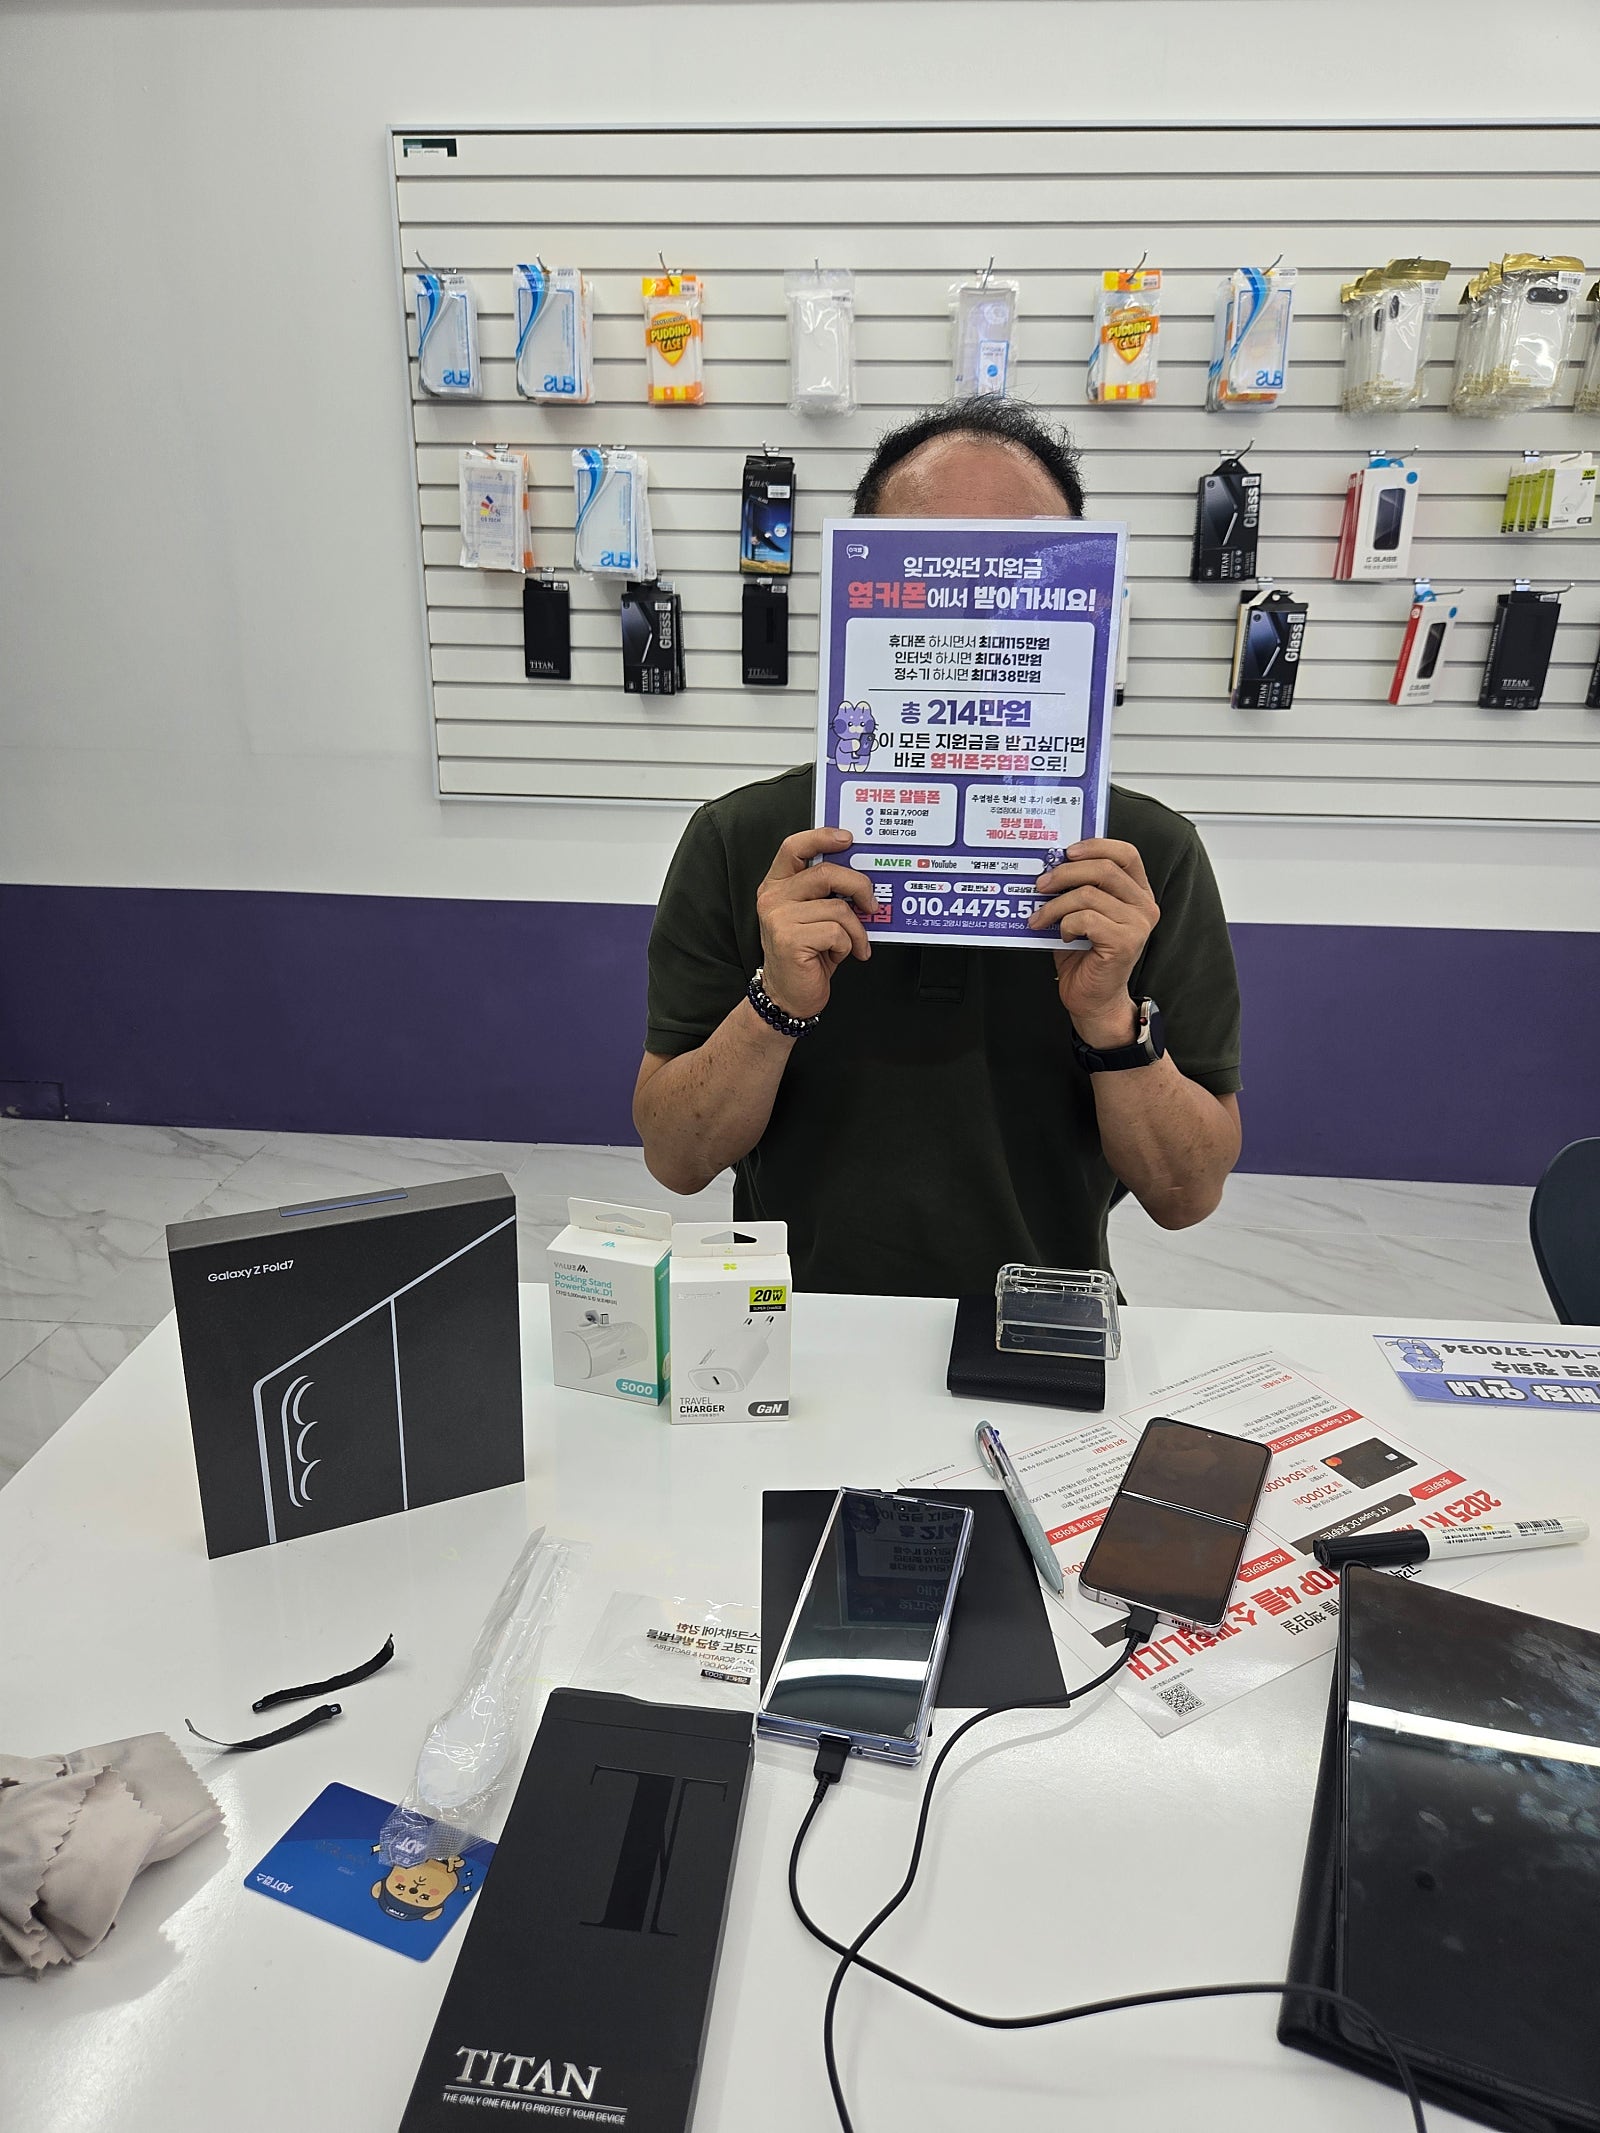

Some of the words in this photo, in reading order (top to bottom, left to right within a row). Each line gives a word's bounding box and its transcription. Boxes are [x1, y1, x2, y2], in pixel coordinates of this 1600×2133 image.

[651, 323, 691, 342] PUDDING
[1108, 320, 1151, 341] PUDDING
[661, 337, 682, 353] CASE
[1120, 335, 1141, 350] CASE
[1243, 487, 1259, 528] Glass
[903, 557, 980, 579] 잊고있던
[984, 557, 1042, 579] 지원금
[1220, 553, 1230, 578] TITAN
[848, 581, 968, 609] 옆커폰에서
[973, 586, 1096, 612] 받아가세요!
[659, 612, 672, 649] Glass
[888, 635, 926, 649] 휴대폰
[928, 635, 977, 649] 하시면서
[978, 635, 1050, 651] 최대115만원
[1284, 623, 1304, 662] Glass
[529, 661, 554, 670] TITAN
[895, 651, 932, 666] 인터넷
[935, 652, 972, 666] 하시면
[975, 653, 1042, 667] 최대61만원
[894, 668, 930, 682] 정수기
[933, 668, 970, 682] 하시면
[971, 668, 1041, 684] 최대38만원
[1501, 678, 1530, 687] TITAN
[1257, 683, 1268, 708] TITAN
[900, 701, 921, 725] 총
[927, 699, 1032, 728] 214만원
[879, 732, 894, 749] 이
[899, 732, 930, 749] 모든
[935, 733, 1000, 751] 지원금을
[1005, 735, 1085, 753] 받고싶다면
[894, 753, 925, 769] 바로
[930, 753, 1068, 772] 옆커폰주엽점으로!
[855, 788, 896, 803] 옆커폰
[899, 789, 940, 805] 알뜰폰
[900, 809, 929, 817] 7,900원
[1000, 817, 1021, 829] 평생
[879, 828, 899, 836] 데이터
[900, 829, 917, 837] 7GB
[986, 829, 1016, 840] 케이스
[1018, 830, 1058, 841] 무료제공
[874, 858, 912, 868] NAVER
[931, 860, 957, 869] YouTube
[910, 883, 937, 891] 제휴카드
[207, 1268, 253, 1282] Galaxy
[253, 1265, 261, 1275] Z
[262, 1259, 294, 1274] Fold7
[554, 1271, 587, 1286] Docking
[588, 1278, 612, 1289] Stand
[1442, 1343, 1600, 1360] -141-370034
[621, 1381, 653, 1395] 5000
[1445, 1378, 1528, 1401] 안내
[679, 1397, 713, 1405] TRAVEL
[679, 1404, 725, 1413] CHARGER
[756, 1404, 782, 1414] GaN
[1317, 1416, 1343, 1430] Super
[1339, 1412, 1354, 1421] KT
[1307, 1425, 1324, 1434] DC
[1266, 1442, 1281, 1451] 장
[1419, 1476, 1453, 1494] 롯데카드
[1289, 1482, 1338, 1507] 21,000원
[1375, 1504, 1391, 1515] KT
[1441, 1488, 1504, 1525] 2025
[1074, 1517, 1095, 1529] 이게
[1344, 1518, 1362, 1529] DC
[1354, 1508, 1381, 1524] Super
[1048, 1524, 1079, 1540] 좋아요!
[1317, 1523, 1350, 1541] 롯데카드
[1267, 1552, 1287, 1564] KB
[1237, 1558, 1274, 1578] 국민카드
[1288, 1563, 1346, 1599] TOP
[1248, 1581, 1307, 1618] 4를
[1316, 1596, 1348, 1618] 를
[1277, 1606, 1328, 1637] 책임질
[256, 1872, 294, 1894] ADT캡스
[455, 2045, 602, 2101] TITAN
[442, 2092, 458, 2103] THE
[459, 2093, 482, 2106] ONLY
[482, 2096, 501, 2108] ONE
[500, 2099, 520, 2111] FILM
[520, 2101, 533, 2112] TO
[533, 2103, 571, 2118] PROTECT
[573, 2109, 596, 2122] YOUR
[595, 2112, 626, 2126] DEVICE
